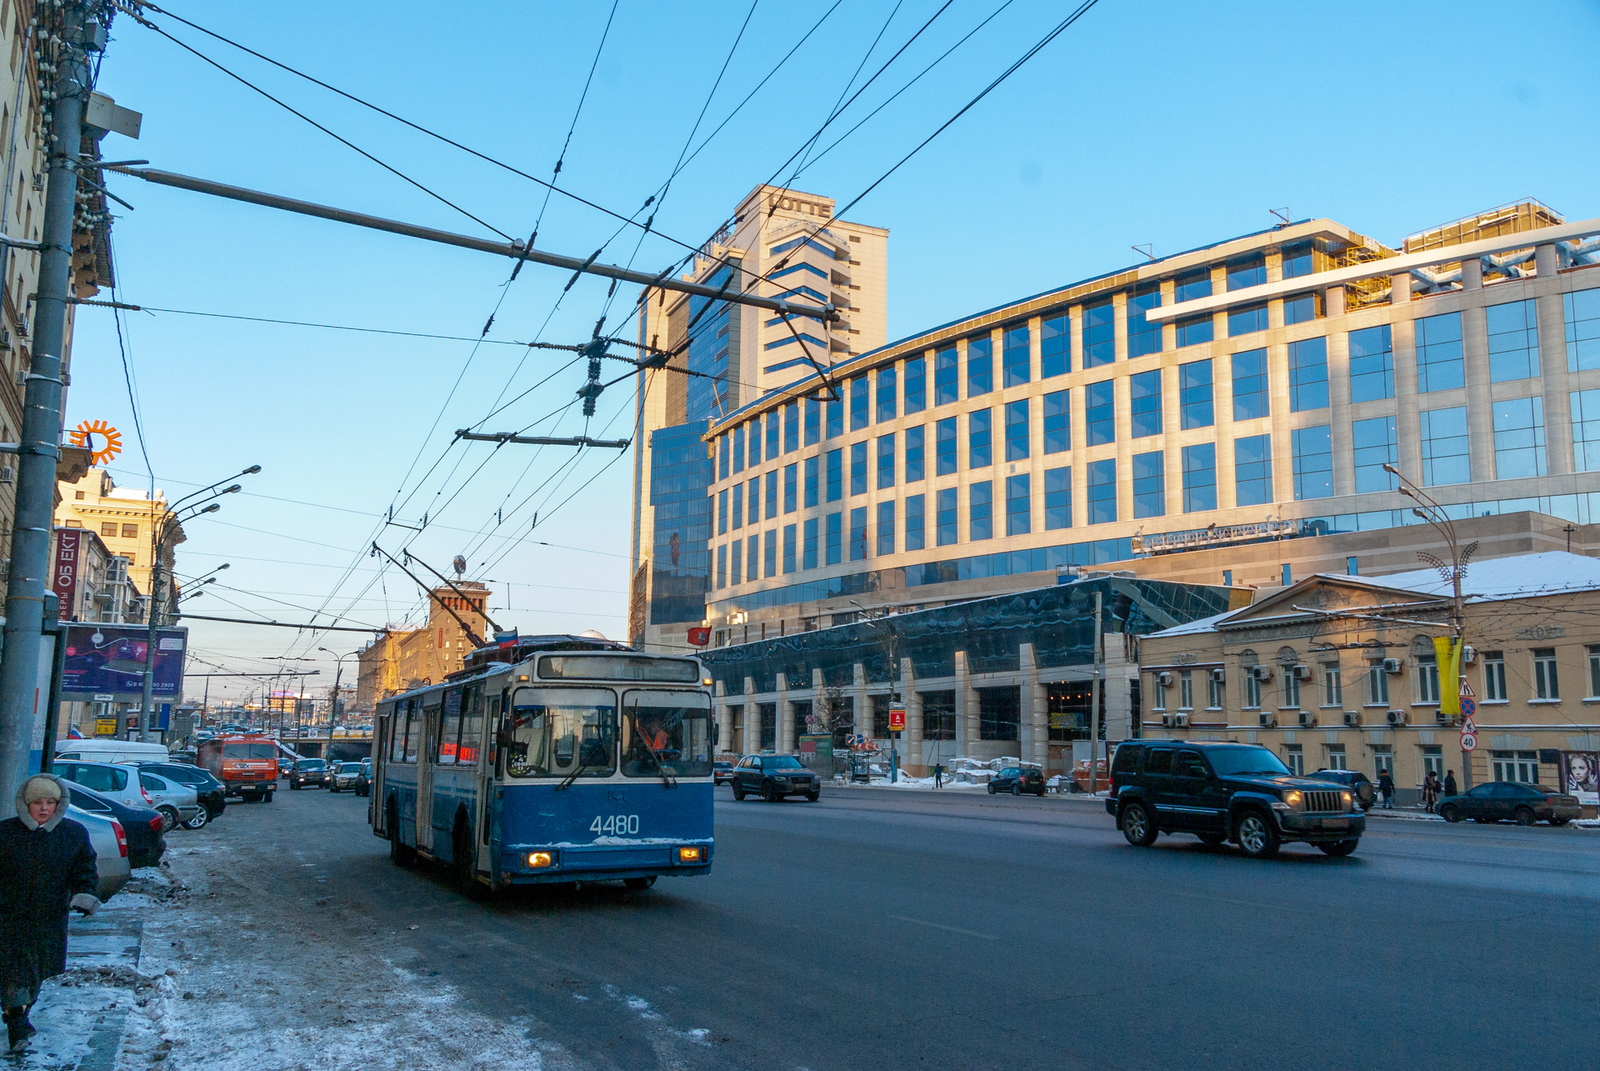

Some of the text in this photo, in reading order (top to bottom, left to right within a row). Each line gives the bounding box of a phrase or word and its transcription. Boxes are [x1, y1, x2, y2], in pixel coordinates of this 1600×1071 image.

[769, 194, 831, 219] LOTTE
[1463, 738, 1473, 746] 40
[589, 814, 639, 836] 4480
